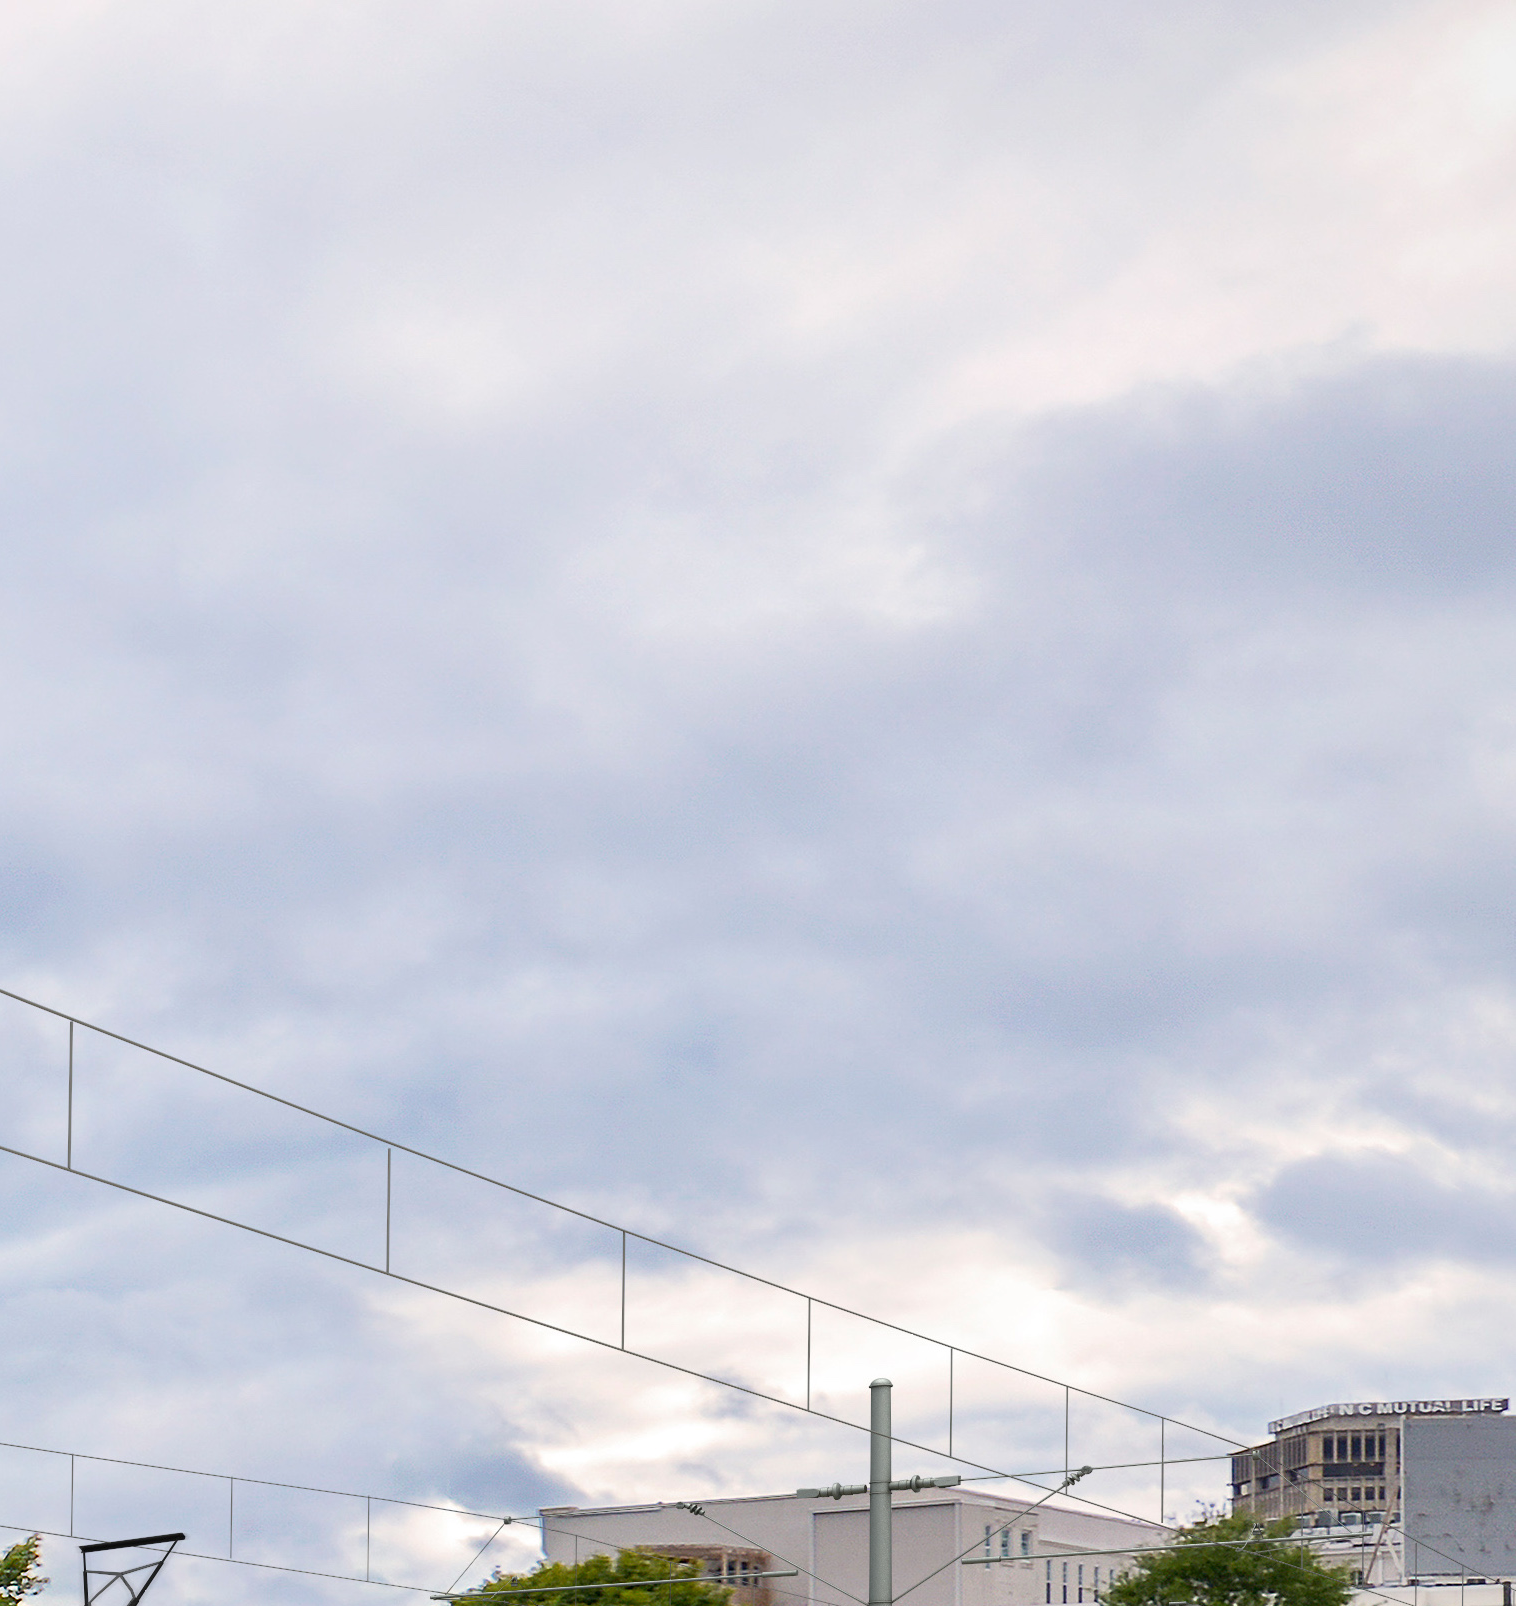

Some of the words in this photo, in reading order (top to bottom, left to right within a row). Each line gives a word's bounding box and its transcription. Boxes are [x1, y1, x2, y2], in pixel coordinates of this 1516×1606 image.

[1339, 1404, 1354, 1415] N
[1358, 1404, 1372, 1415] C
[1376, 1401, 1451, 1414] MUTUAL
[1461, 1399, 1504, 1412] LIFE
